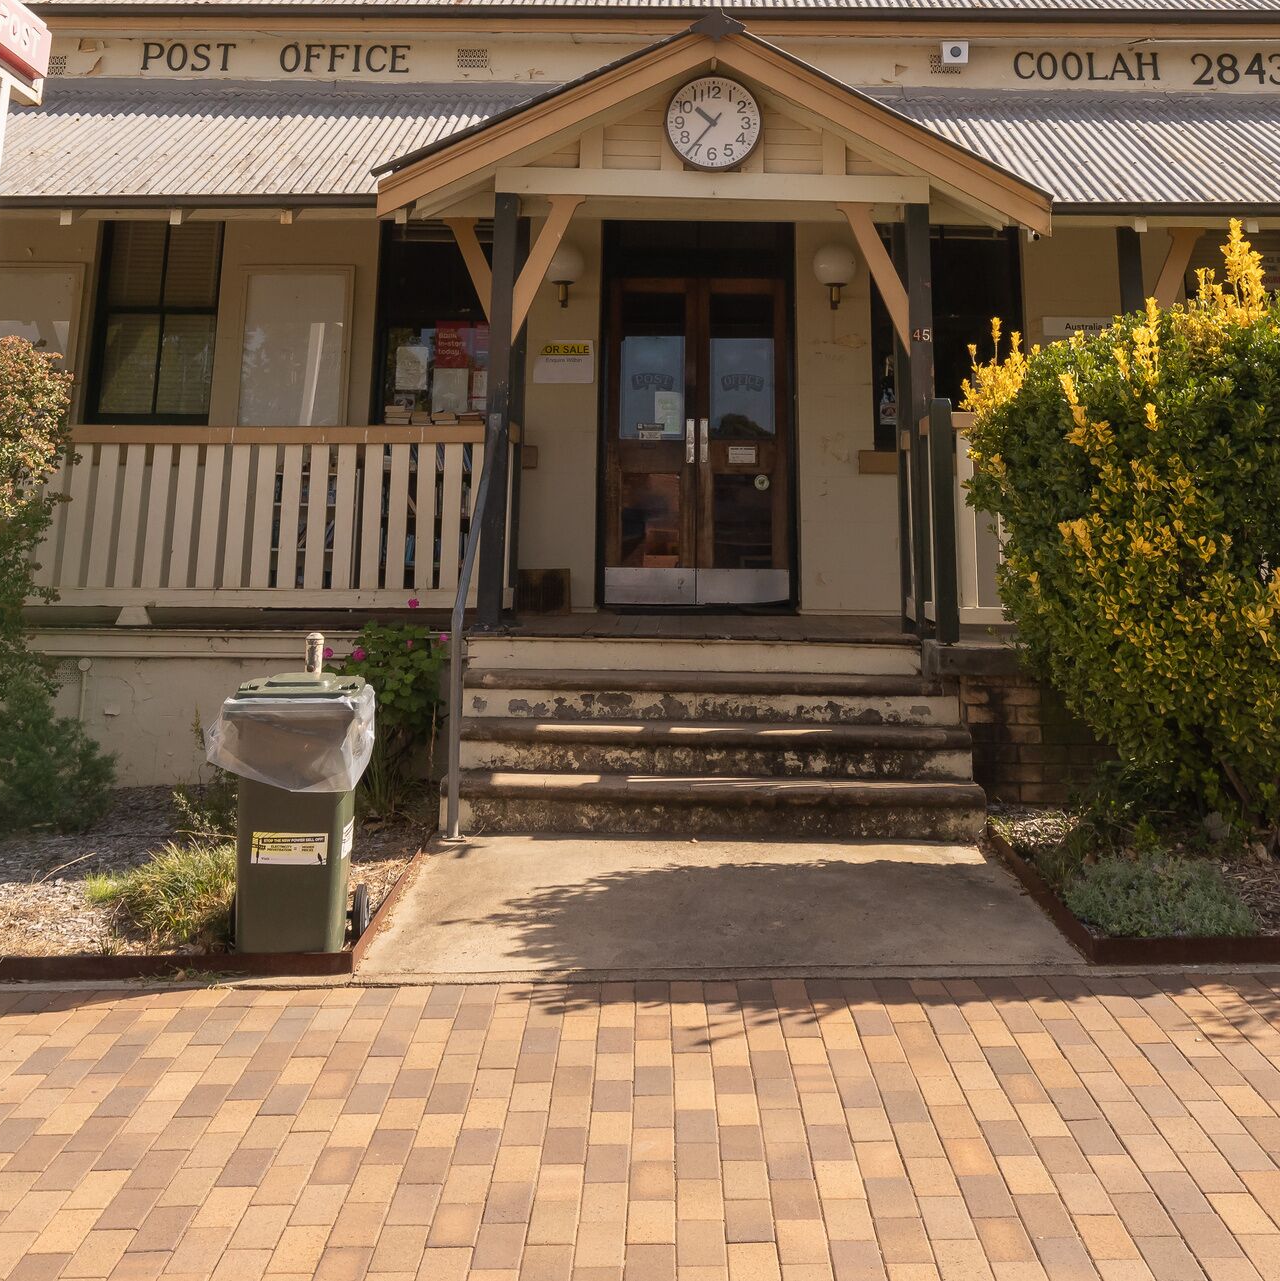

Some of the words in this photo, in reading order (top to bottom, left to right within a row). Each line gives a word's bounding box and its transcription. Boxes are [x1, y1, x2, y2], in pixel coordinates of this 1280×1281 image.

[140, 43, 237, 71] POST
[279, 43, 411, 73] OFFICE
[1013, 51, 1161, 81] COOLAH
[693, 89, 704, 102] 11
[707, 86, 721, 99] 12
[728, 89, 732, 102] 1
[679, 100, 693, 114] 10
[736, 100, 747, 114] 2
[674, 116, 685, 130] 9
[740, 116, 751, 130] 3
[680, 130, 690, 144] 8
[735, 132, 747, 145] 4
[694, 143, 703, 157] 7
[706, 147, 718, 161] 6
[723, 143, 734, 157] 5
[1064, 322, 1102, 331] Australia
[913, 329, 930, 341] 45
[543, 345, 560, 354] OR
[562, 345, 590, 354] SALE
[634, 373, 670, 385] POST
[723, 374, 762, 386] OFFICE
